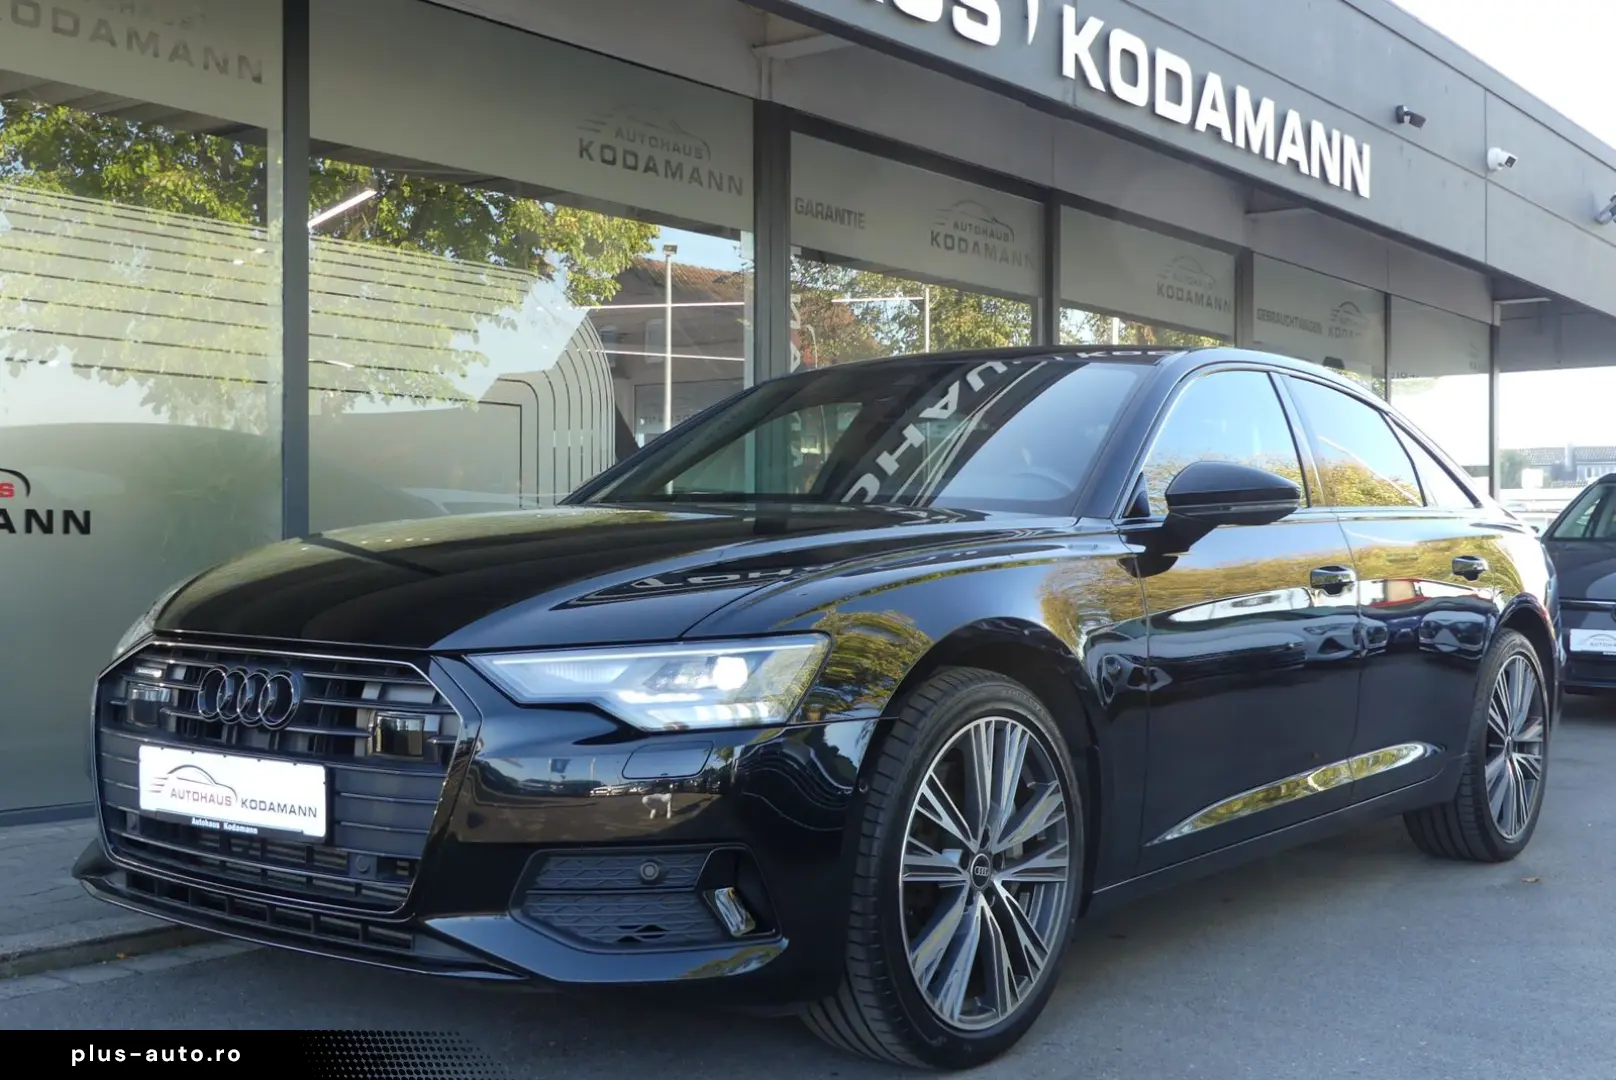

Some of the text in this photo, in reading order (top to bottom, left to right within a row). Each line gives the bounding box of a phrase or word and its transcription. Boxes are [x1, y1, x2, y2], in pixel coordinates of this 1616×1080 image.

[0, 0, 264, 85] ODAMANN
[1061, 3, 1370, 199] KODAMANN
[614, 126, 704, 160] AUTOHAUS
[578, 137, 744, 197] KODAMANN
[794, 197, 866, 230] GARANTIE
[952, 220, 1010, 242] AUTOHAUS
[930, 229, 1036, 272] KODAMANN
[1156, 280, 1232, 314] KODAMANN
[170, 787, 318, 819] AUTOHAUS KODAMANN
[191, 816, 259, 835] Autohaus Kodamann
